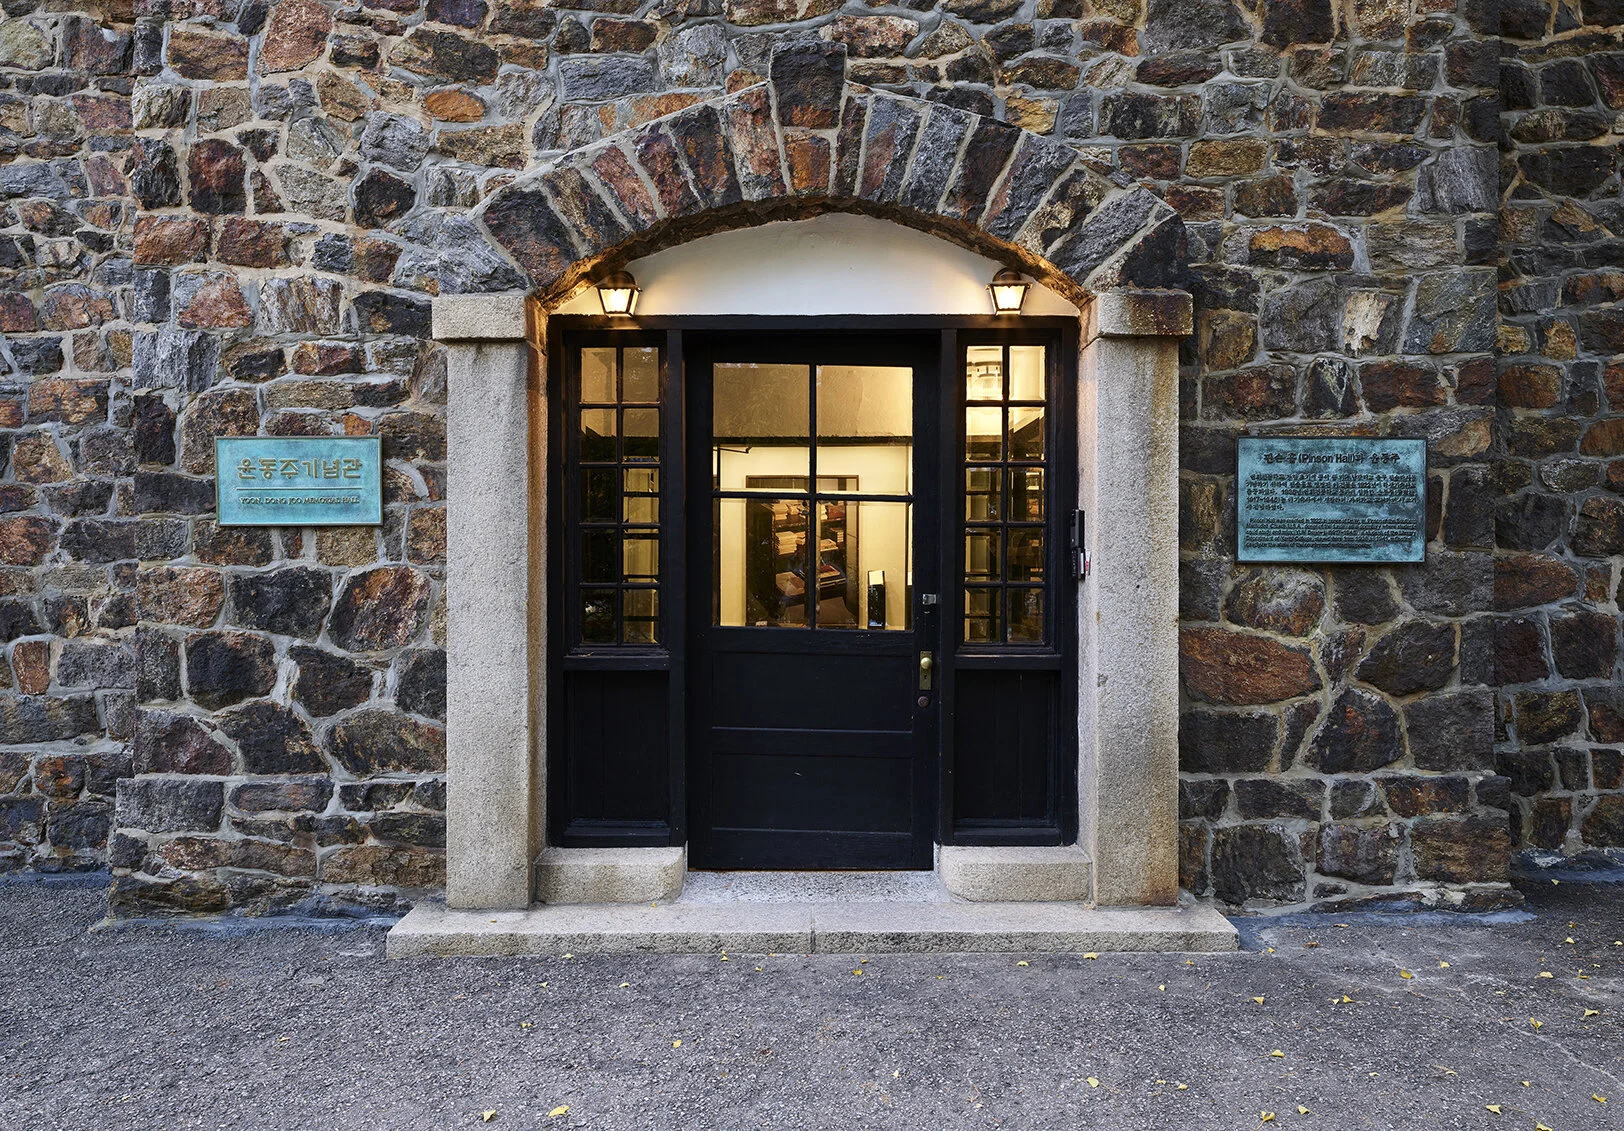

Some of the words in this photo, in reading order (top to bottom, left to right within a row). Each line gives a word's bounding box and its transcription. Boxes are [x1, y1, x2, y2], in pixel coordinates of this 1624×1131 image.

[1369, 452, 1401, 464] 윤동주
[237, 457, 363, 480] 윤동주기념관
[265, 496, 287, 505] DONG
[288, 496, 303, 505] JOO
[303, 496, 340, 504] MEMORIAL
[341, 495, 360, 504] HALL
